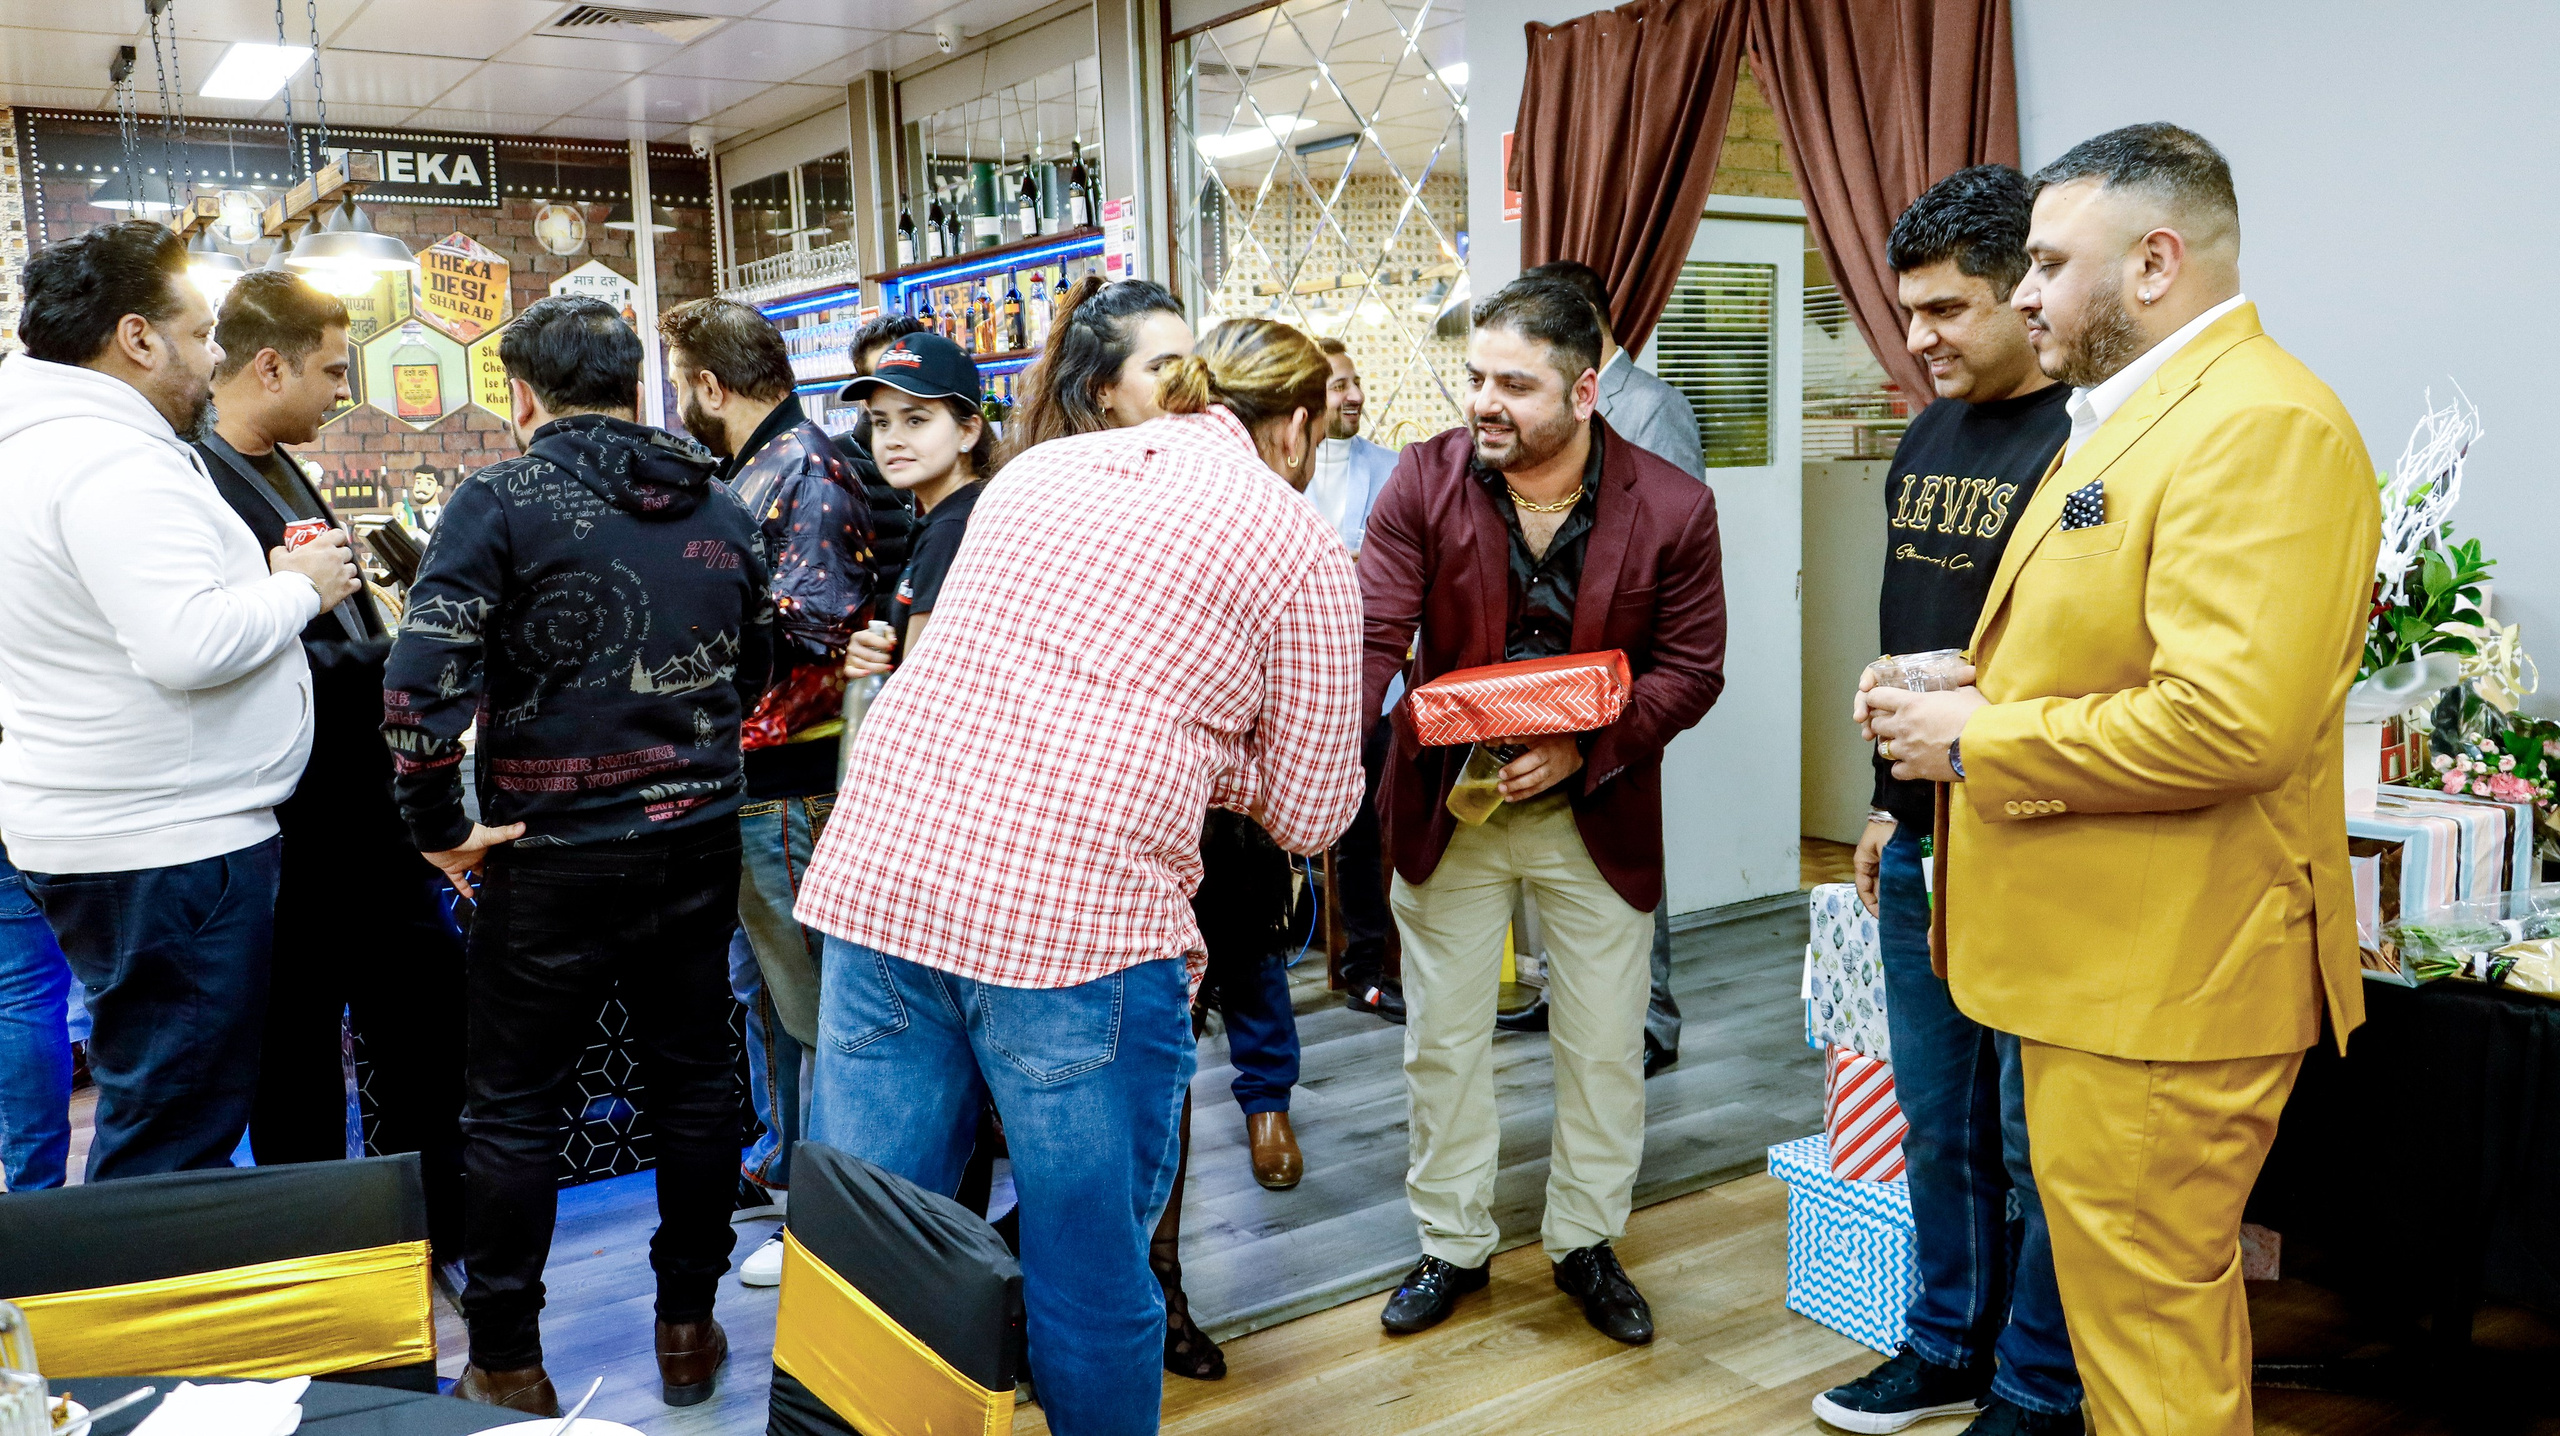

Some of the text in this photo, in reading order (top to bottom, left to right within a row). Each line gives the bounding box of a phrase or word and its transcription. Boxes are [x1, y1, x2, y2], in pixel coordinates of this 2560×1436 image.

[429, 252, 492, 281] THEKA
[431, 272, 488, 304] DESI
[429, 293, 494, 321] SHARAB
[1892, 474, 2019, 539] LEVI'S
[683, 540, 740, 569] 27/12
[598, 744, 677, 770] NATURE
